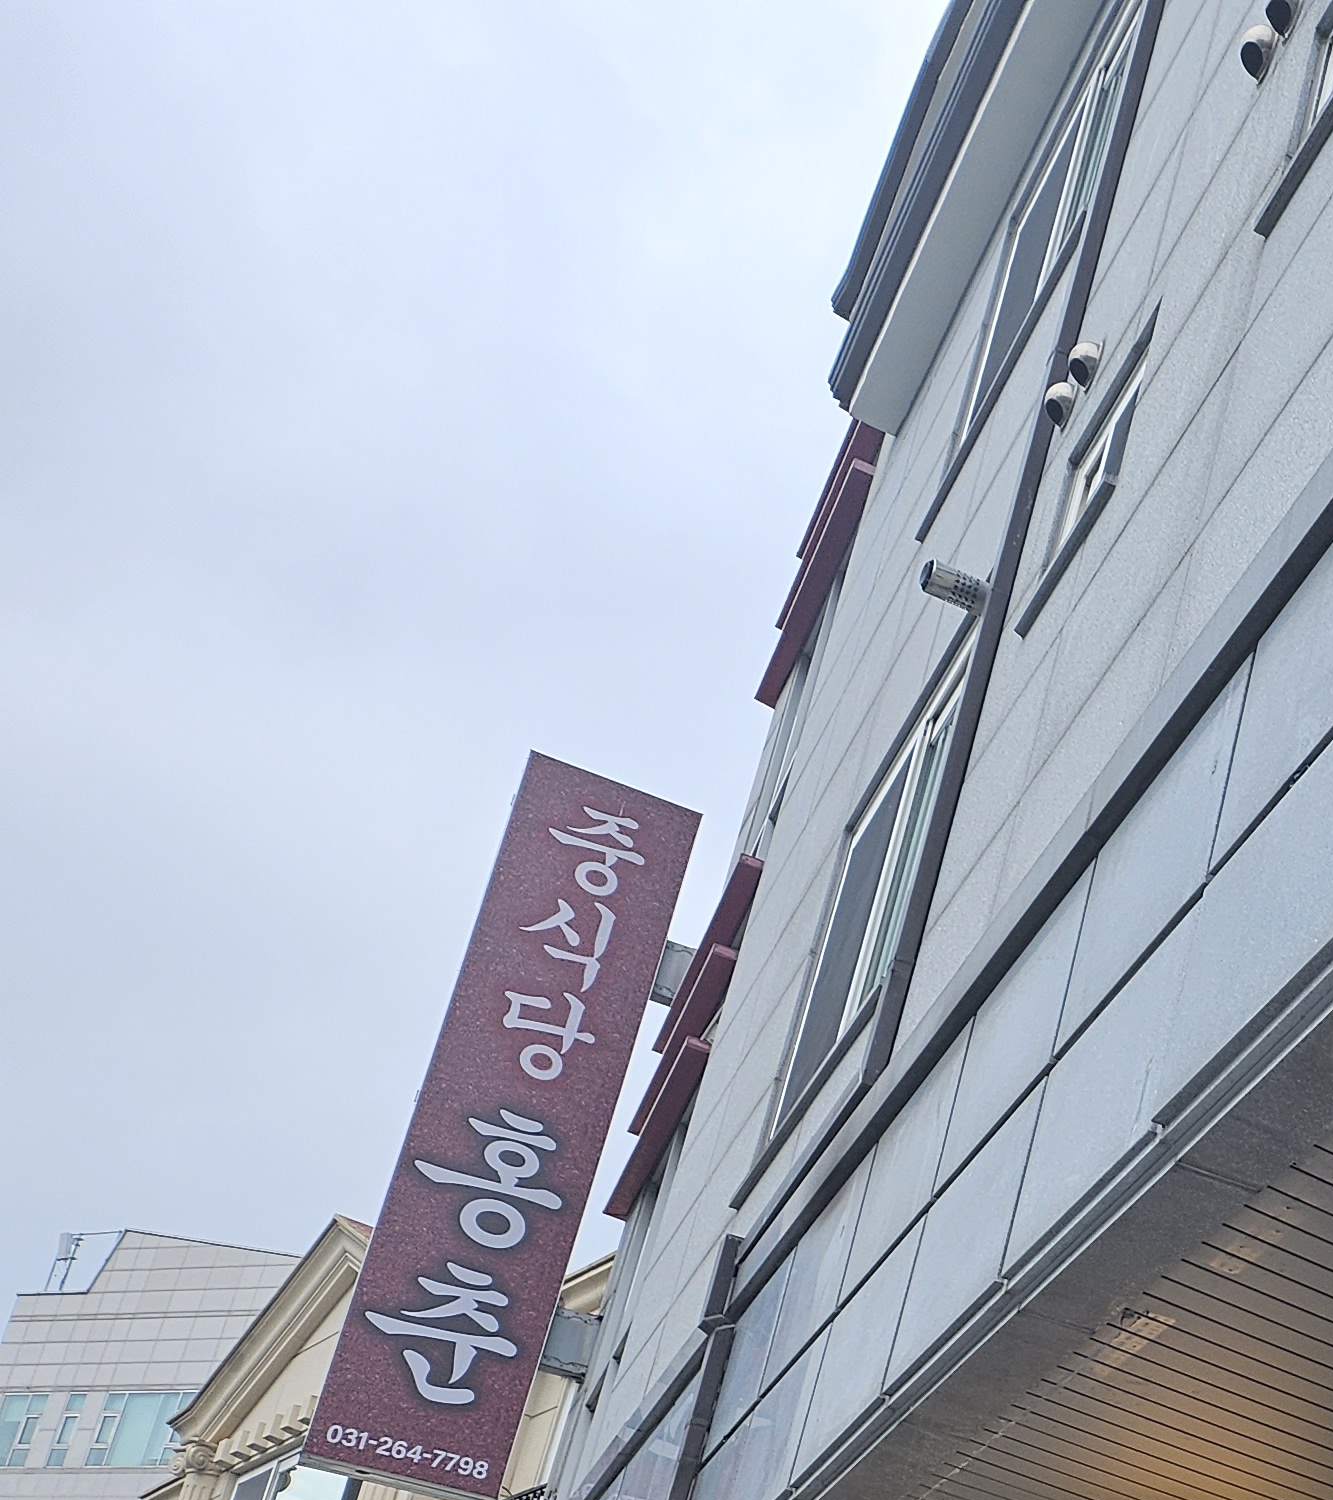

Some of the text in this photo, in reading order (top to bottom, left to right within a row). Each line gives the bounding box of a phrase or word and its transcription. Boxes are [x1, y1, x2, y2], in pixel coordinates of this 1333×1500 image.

[502, 805, 645, 1081] 중식당
[365, 1108, 562, 1405] 홍춘
[326, 1425, 488, 1479] 031-264-7798
